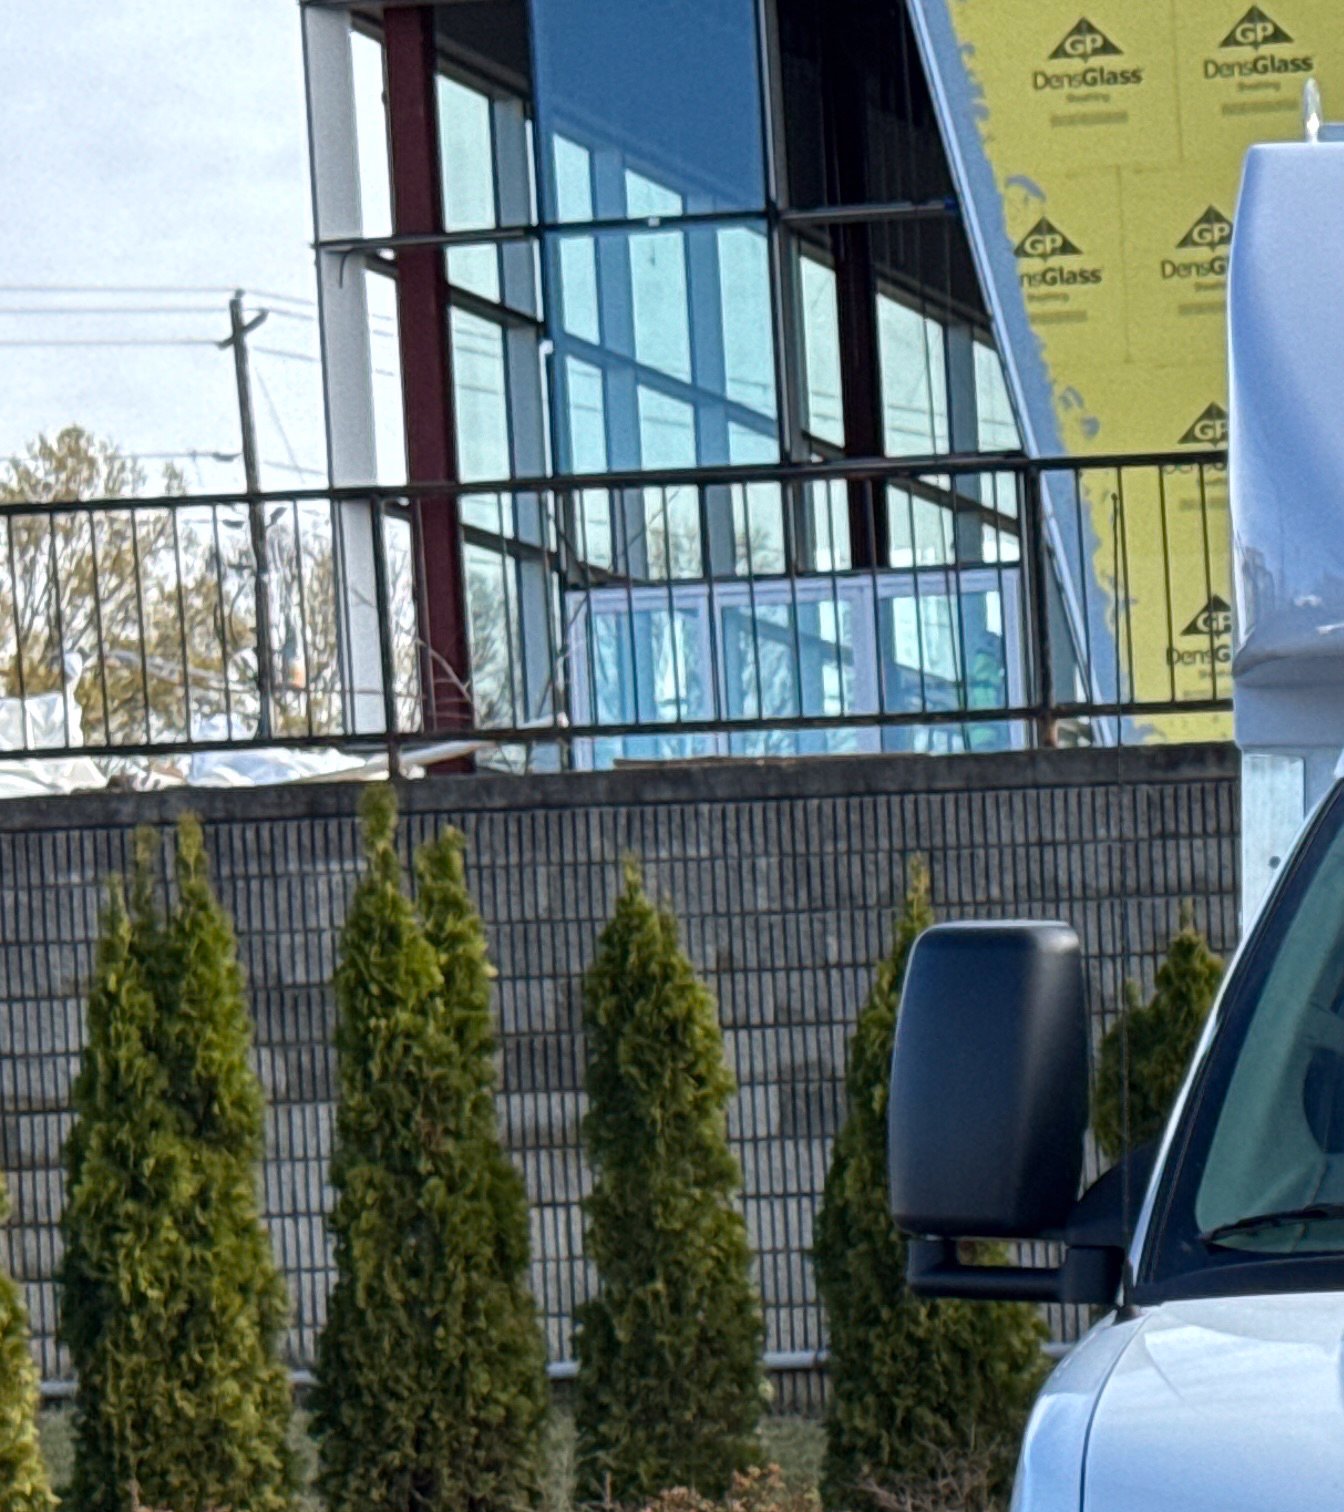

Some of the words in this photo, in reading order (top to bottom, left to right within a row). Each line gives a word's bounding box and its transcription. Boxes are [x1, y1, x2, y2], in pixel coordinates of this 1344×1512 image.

[1064, 33, 1104, 55] GP
[1235, 22, 1275, 44] GP
[1203, 54, 1315, 79] DensGlass
[1032, 66, 1143, 91] DensGlass
[1192, 223, 1231, 244] GP
[1023, 234, 1064, 256] GP
